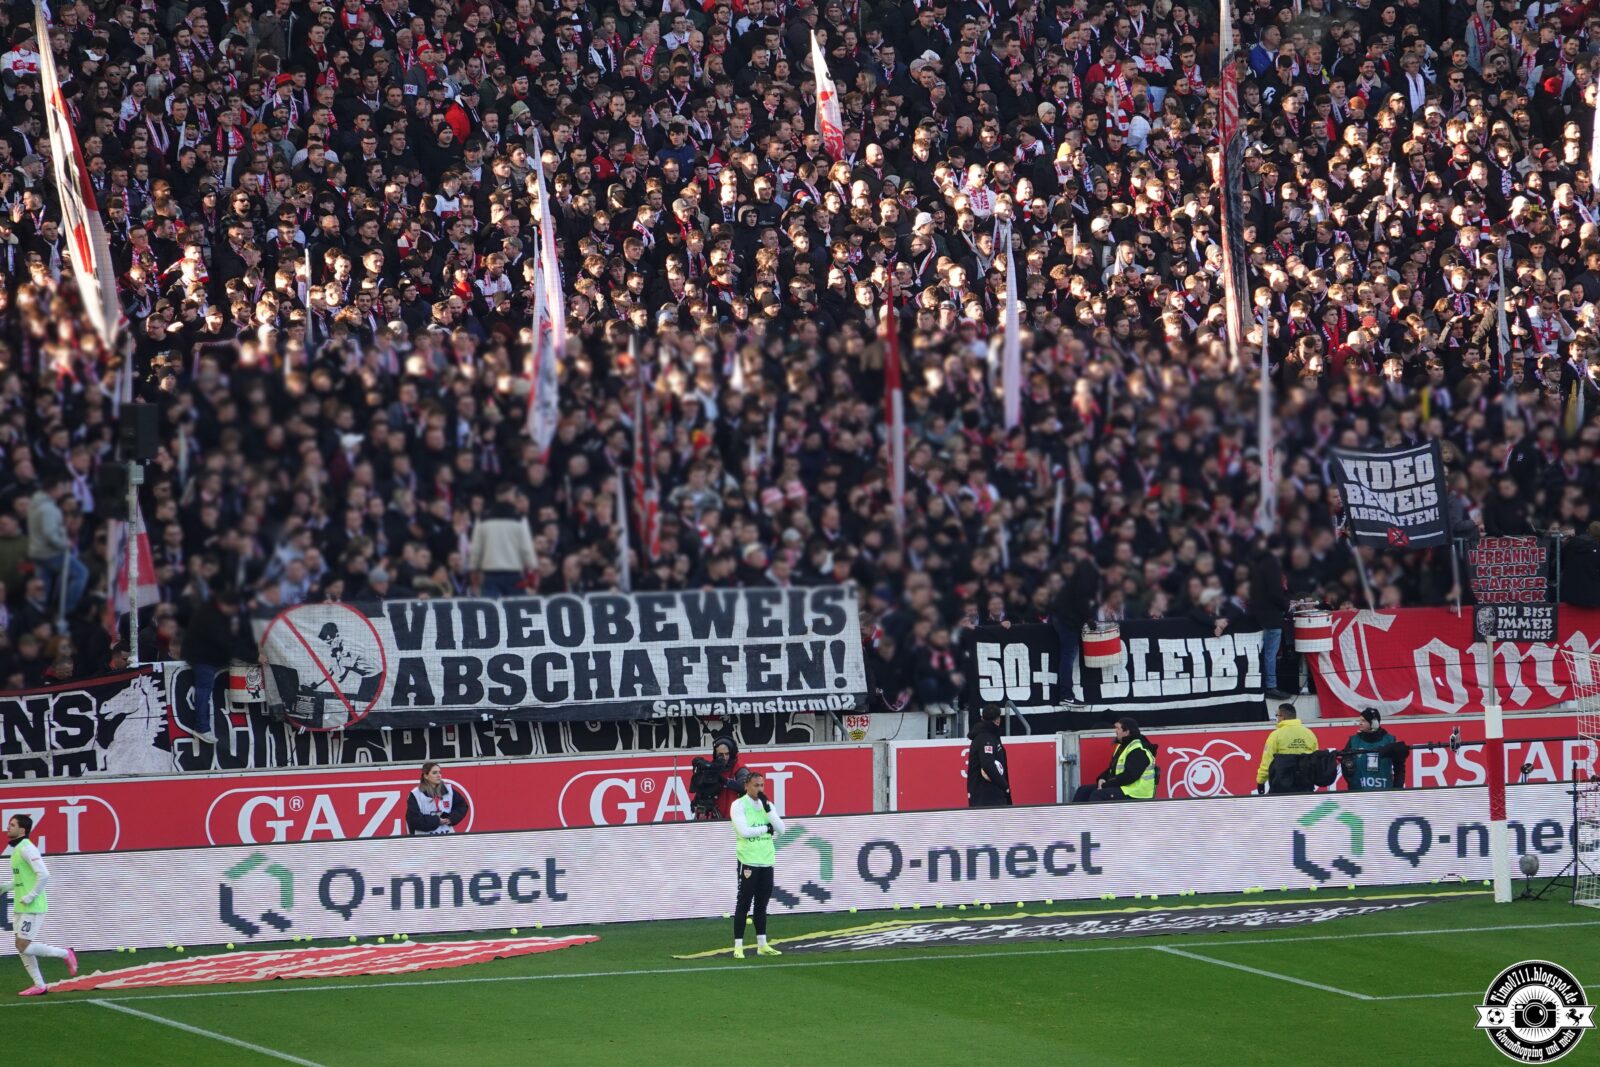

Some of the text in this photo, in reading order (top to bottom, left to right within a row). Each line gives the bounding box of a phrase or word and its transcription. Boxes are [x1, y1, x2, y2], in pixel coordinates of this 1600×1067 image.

[1337, 452, 1435, 490] VIDEO
[1343, 483, 1439, 513] BEWEIS
[1349, 506, 1440, 527] ABSCHAFFEN!
[1477, 535, 1537, 549] JEDER
[1468, 547, 1547, 565] VERBANNTE
[1476, 564, 1539, 577] KEHRT
[387, 586, 848, 651] VIDEOBEWEIS
[1497, 606, 1553, 617] DU BIST
[1497, 618, 1553, 629] IMMER
[1497, 630, 1554, 640] BEI UNS!
[390, 639, 848, 707] ABSCHAFFEN!
[1099, 631, 1264, 699] BLEIBT
[652, 693, 857, 719] Schwabensturm02
[1360, 776, 1388, 788] HOST
[856, 831, 1104, 893] Q-nnect
[317, 857, 569, 922] Q-nnect
[21, 920, 32, 933] 20
